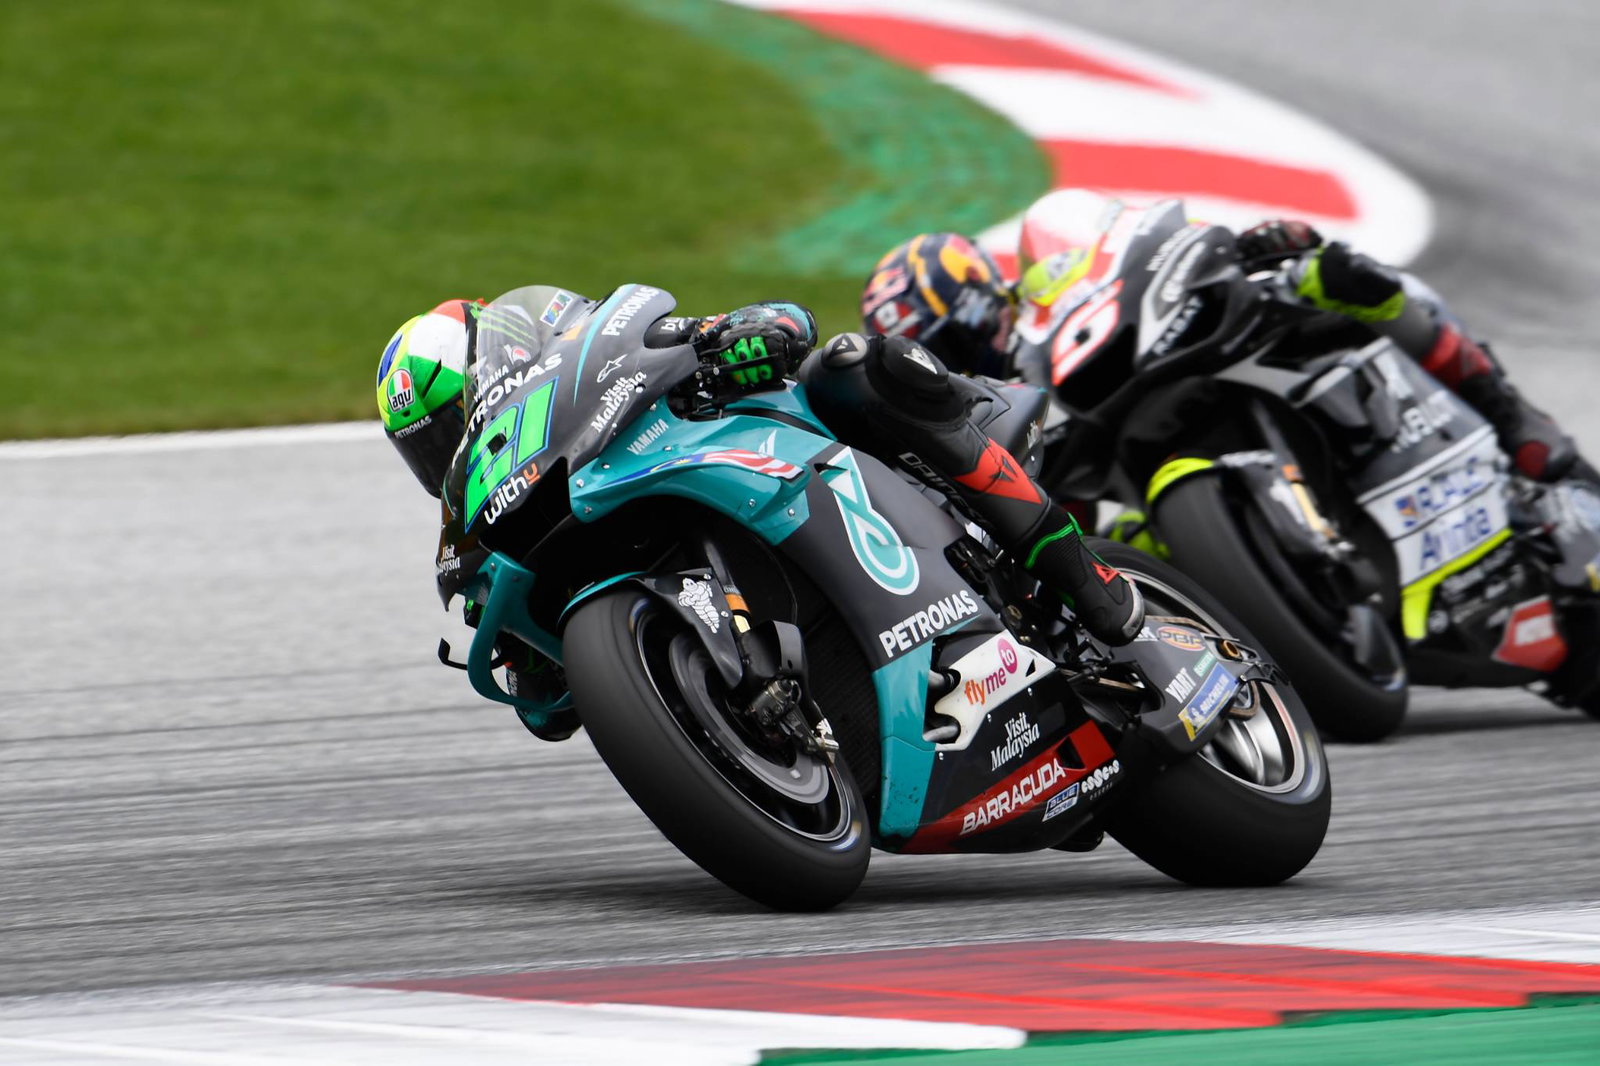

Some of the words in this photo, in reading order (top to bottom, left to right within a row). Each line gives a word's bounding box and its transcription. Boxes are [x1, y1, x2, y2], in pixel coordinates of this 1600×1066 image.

[601, 286, 660, 337] PETRONAS
[391, 389, 411, 409] agv
[451, 352, 563, 470] TRONAS
[591, 371, 647, 433] Malaysia
[600, 377, 629, 402] Visit
[394, 415, 432, 439] PETRONAS
[626, 418, 669, 455] YAMAHA
[464, 375, 559, 535] 21
[879, 589, 979, 659] PETRONAS
[990, 721, 1041, 772] Malaysia
[1004, 712, 1031, 741] Visit
[959, 757, 1067, 836] BARRACUDA
